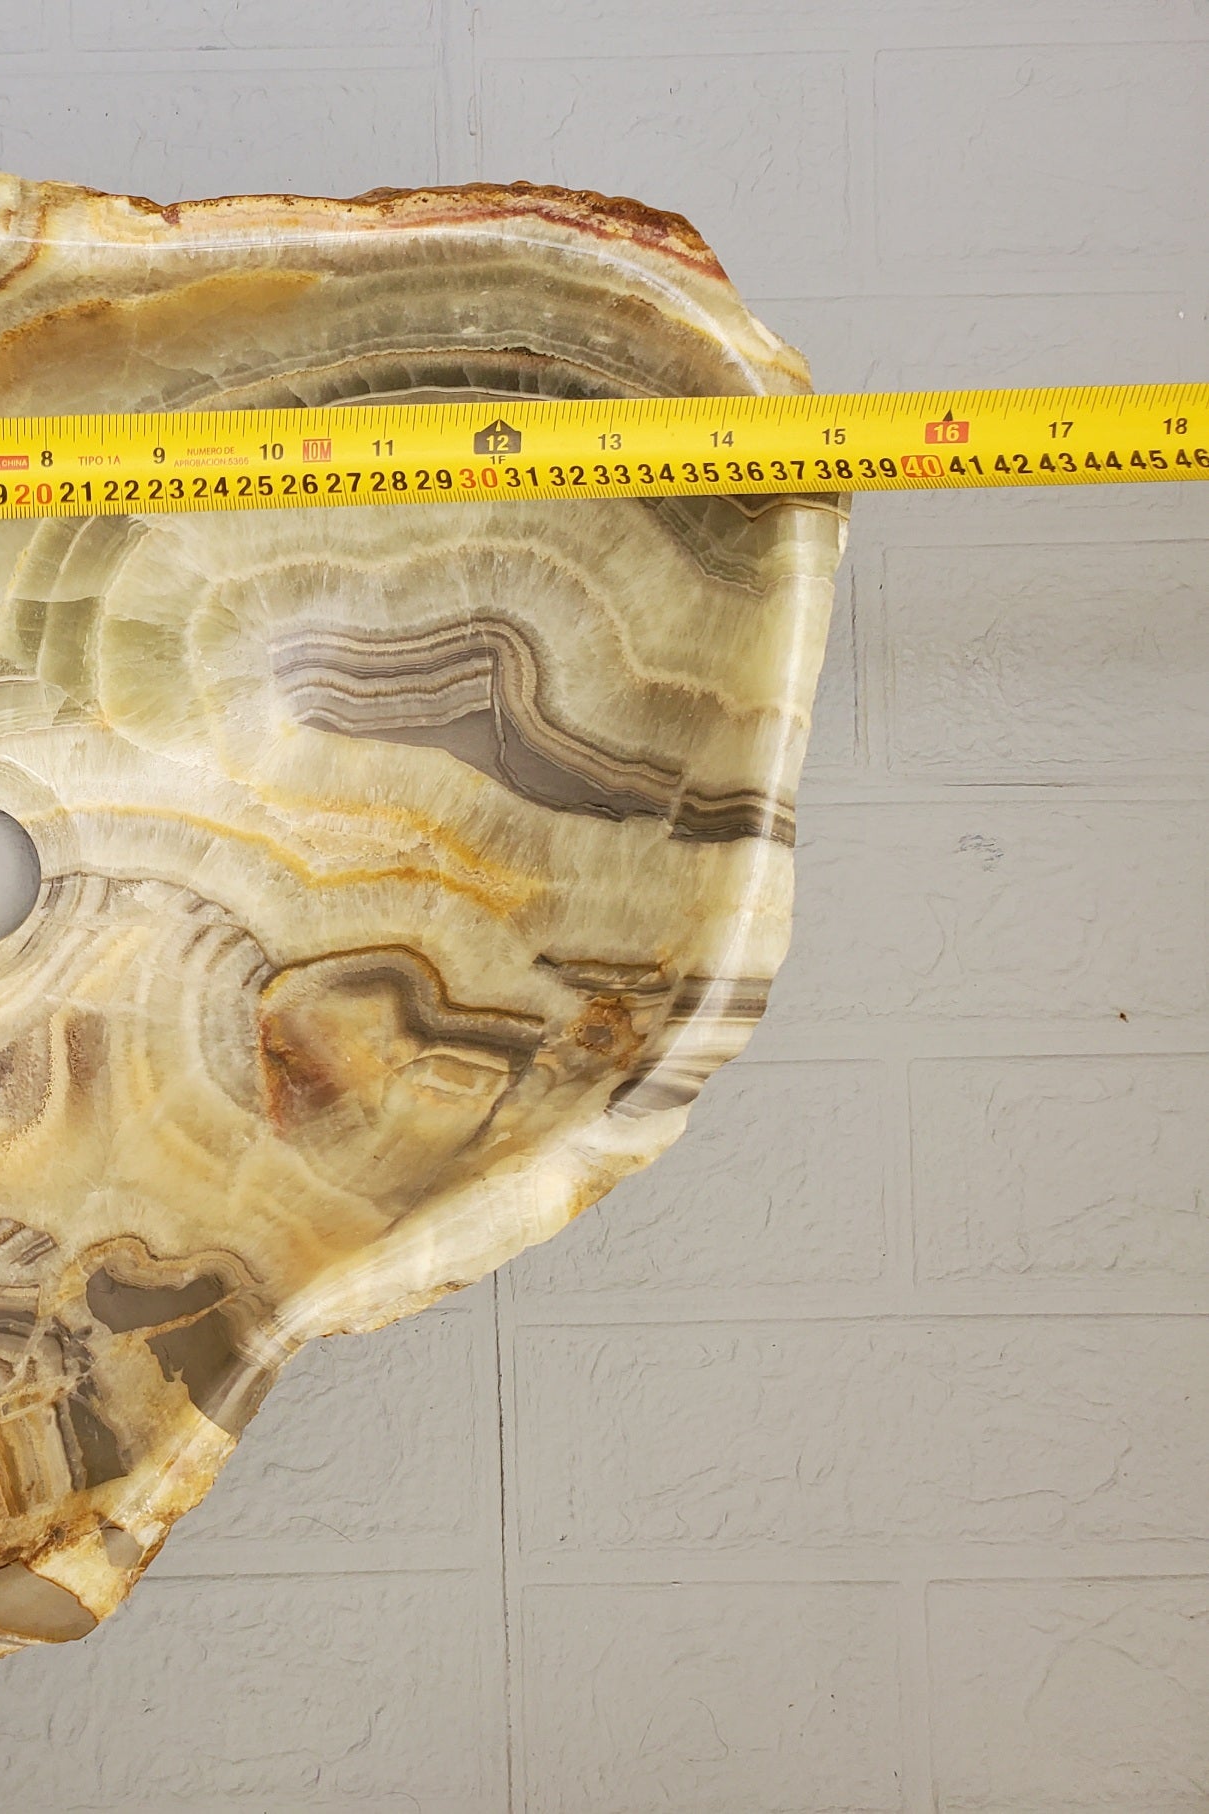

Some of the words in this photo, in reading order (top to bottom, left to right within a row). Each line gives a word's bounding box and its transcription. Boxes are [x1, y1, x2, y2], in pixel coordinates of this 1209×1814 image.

[40, 450, 53, 468] 8
[153, 447, 165, 464] 9
[259, 443, 284, 461] 10
[372, 439, 394, 456] 11
[486, 435, 509, 452] 12
[597, 433, 622, 450] 13
[710, 430, 734, 448] 14
[821, 428, 846, 445] 15
[933, 424, 959, 442] 16
[1048, 421, 1073, 438] 17
[1163, 418, 1188, 434] 18
[187, 447, 222, 456] NUMERO
[224, 446, 235, 455] DE
[303, 439, 331, 461] NOM
[2, 459, 28, 467] CHINA
[78, 455, 103, 466] TIPO
[108, 455, 121, 465] 1A
[15, 483, 53, 505] 20
[59, 481, 92, 503] 21
[103, 480, 140, 501] 22
[148, 478, 185, 500] 23
[192, 477, 229, 498] 24
[237, 475, 273, 497] 25
[281, 474, 318, 495] 26
[326, 472, 362, 494] 27
[370, 471, 407, 492] 28
[414, 469, 452, 491] 29
[460, 468, 498, 489] 30
[505, 467, 539, 487] 31
[549, 466, 587, 487] 32
[593, 464, 631, 485] 33
[637, 463, 674, 484] 34
[682, 462, 720, 483] 35
[726, 461, 764, 482] 36
[770, 460, 806, 481] 37
[814, 459, 853, 480] 38
[858, 457, 898, 478] 39
[905, 456, 941, 476] 40
[949, 455, 983, 476] 41
[994, 454, 1033, 474] 42
[1039, 452, 1078, 473] 43
[1084, 451, 1123, 471] 44
[1129, 450, 1168, 470] 45
[1176, 448, 1209, 468] 46
